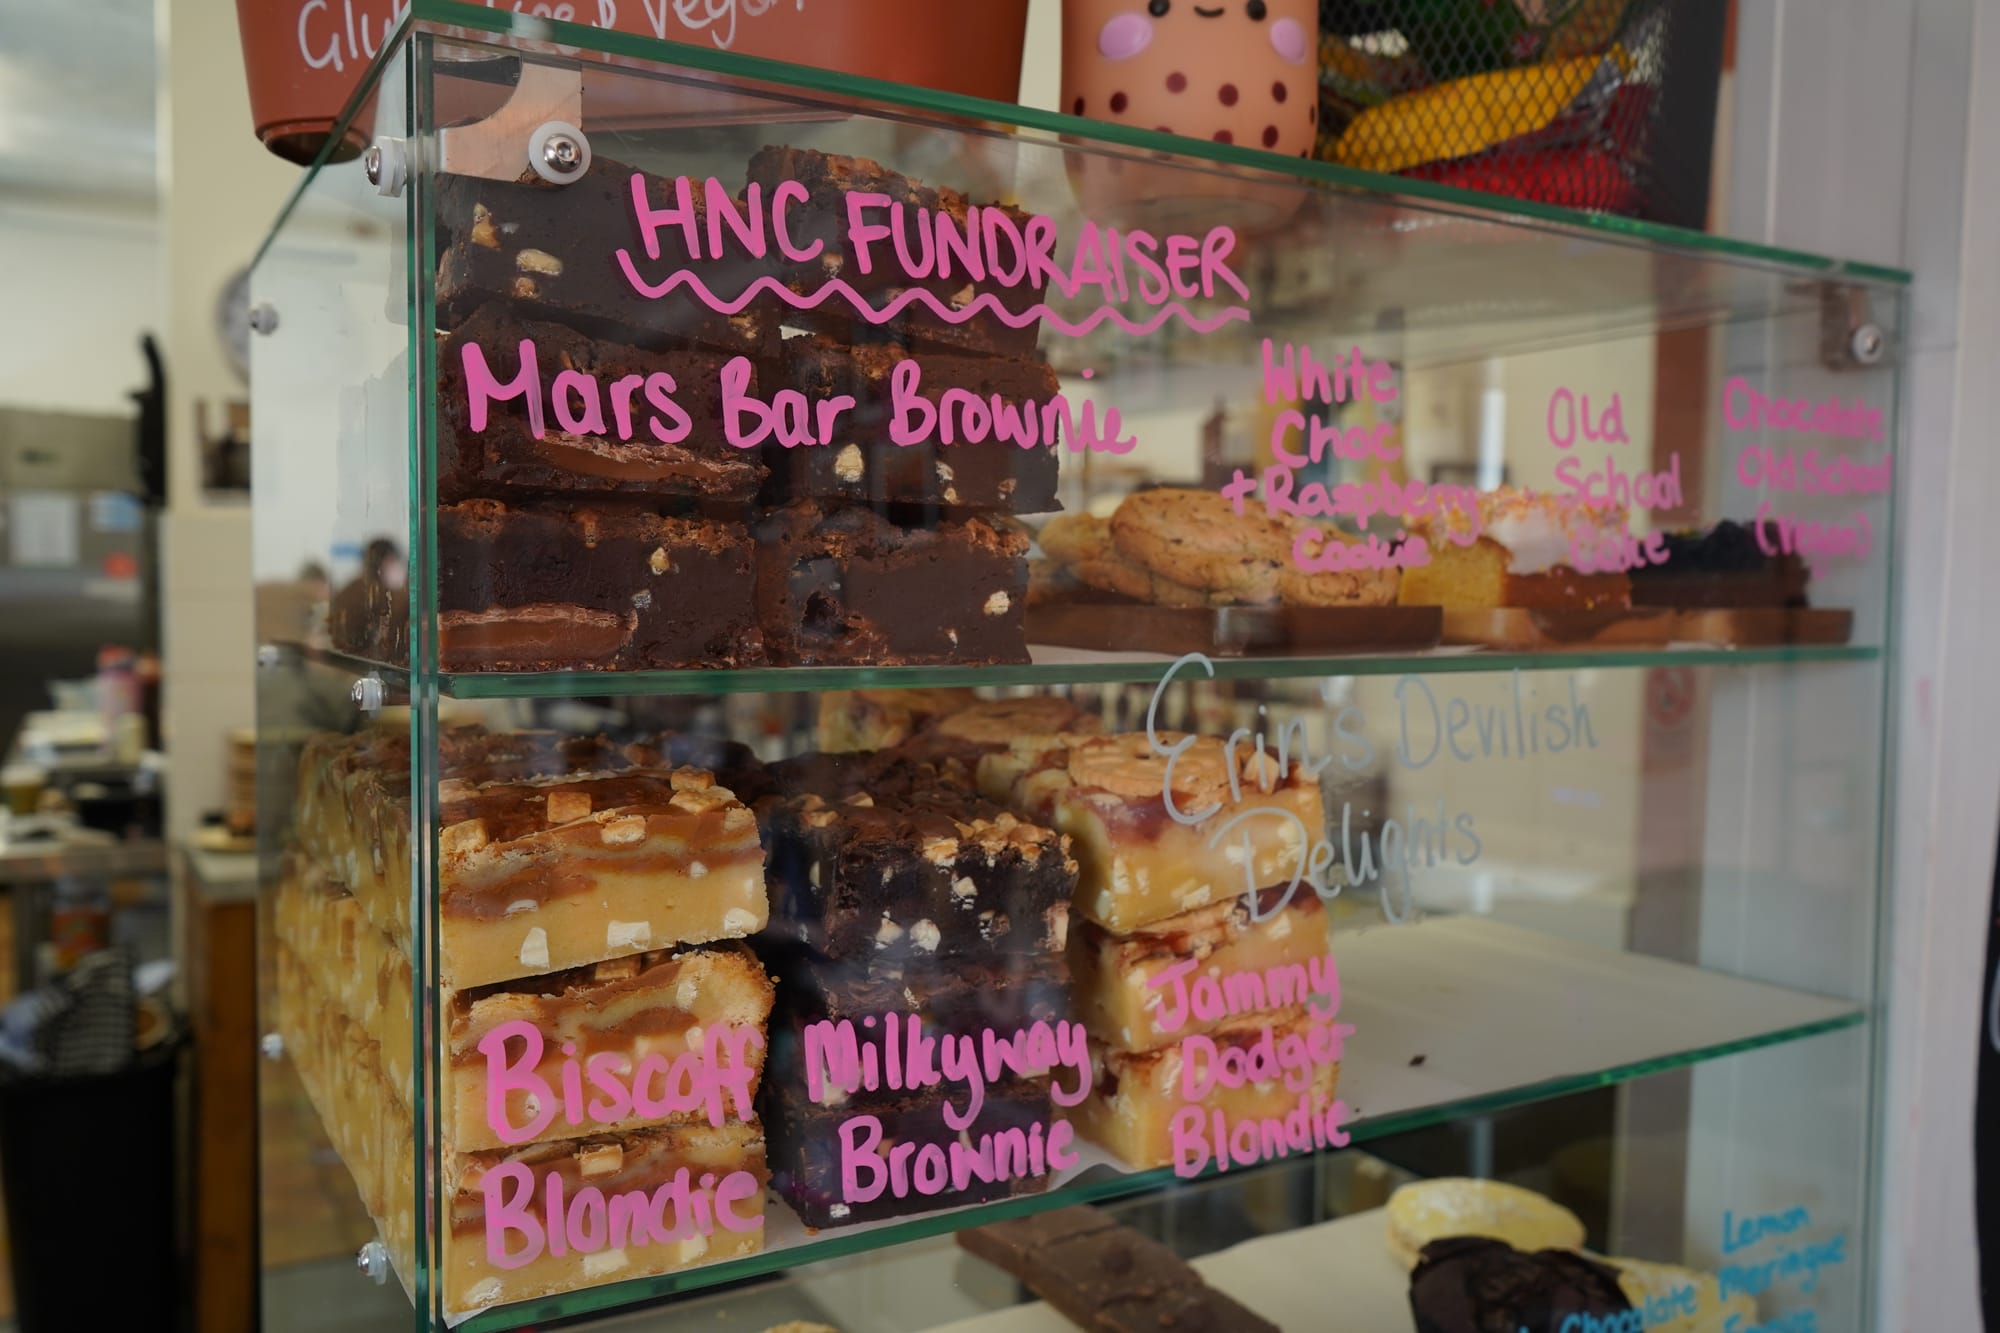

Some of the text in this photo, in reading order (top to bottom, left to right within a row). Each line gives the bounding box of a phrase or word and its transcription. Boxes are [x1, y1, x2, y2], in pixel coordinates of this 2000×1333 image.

[629, 172, 1251, 306] HNC FUNDRAISER
[461, 337, 1138, 456] Mars Bar Brownie
[1261, 337, 1399, 405] White
[1270, 408, 1402, 469] Choc
[1546, 386, 1631, 449] Old
[1554, 449, 1684, 513] School
[1735, 444, 1796, 492] Old
[1291, 526, 1434, 573] Cookie
[1568, 521, 1672, 576] Cake
[1395, 666, 1600, 770] Devilish
[1208, 800, 1484, 925] Delights
[1146, 953, 1342, 1032] Jammy
[476, 1018, 767, 1144] Biscoff
[803, 1011, 1094, 1131] Milkyway
[837, 1114, 1080, 1204] Brownie
[1172, 1093, 1351, 1178] Blondie
[479, 1160, 767, 1270] Blondie
[1722, 1204, 1811, 1255] Lemon
[1556, 1283, 1699, 1333] Chocolate
